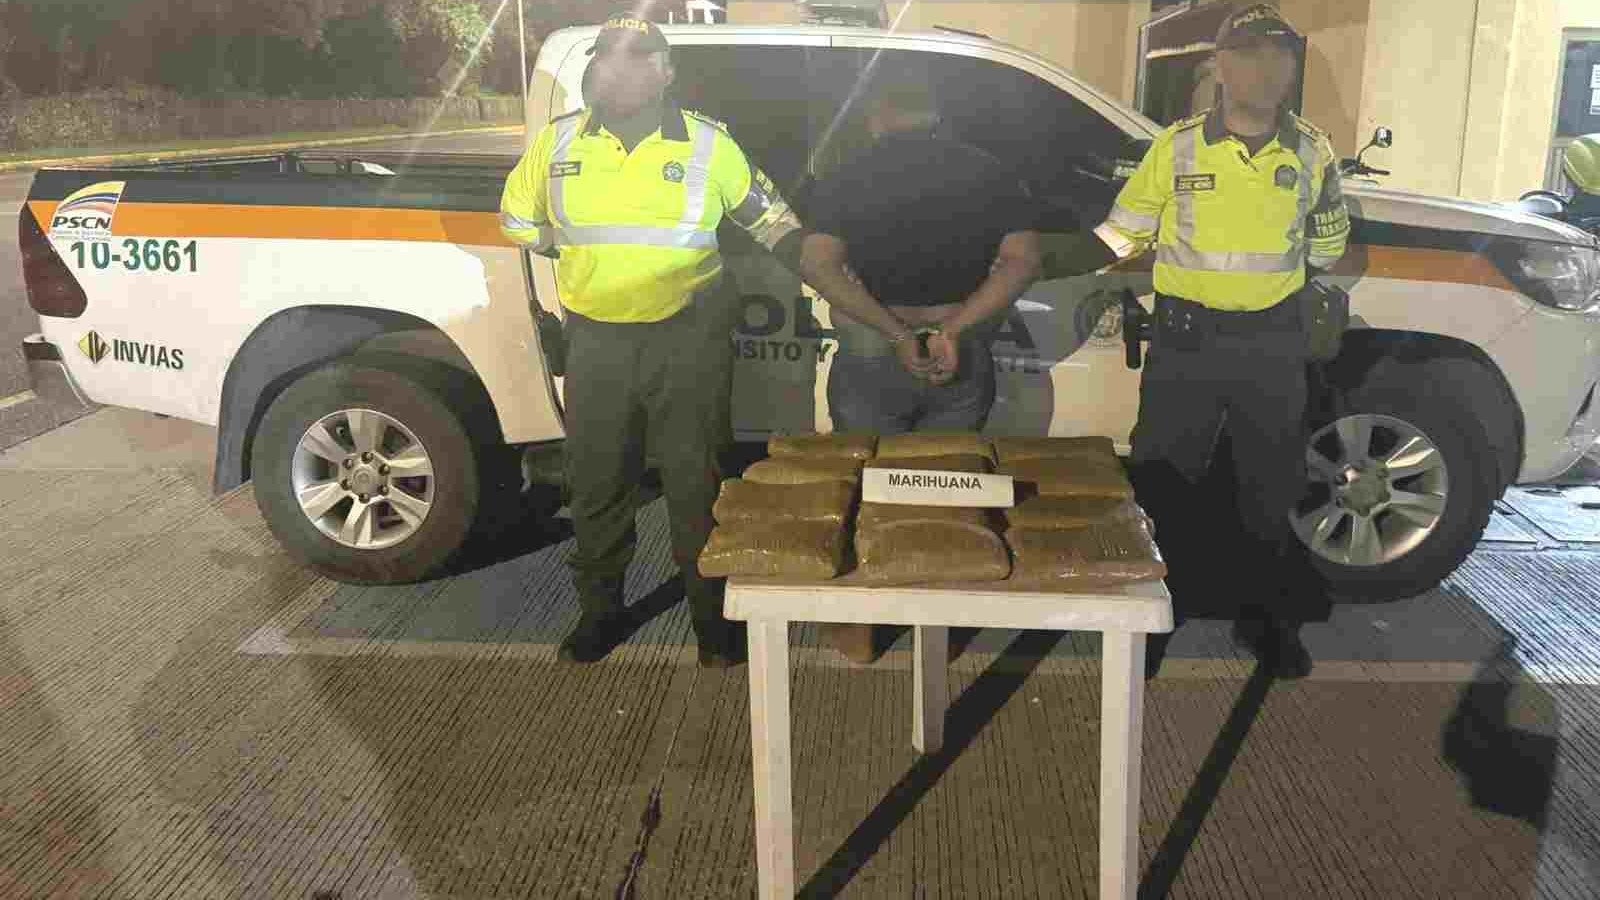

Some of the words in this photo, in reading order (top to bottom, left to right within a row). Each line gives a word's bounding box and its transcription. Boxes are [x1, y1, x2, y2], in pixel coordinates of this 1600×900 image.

[52, 215, 111, 229] PSCN
[70, 238, 197, 272] 10-3661
[113, 338, 184, 370] INVIAS
[888, 473, 982, 490] MARIHUANA
